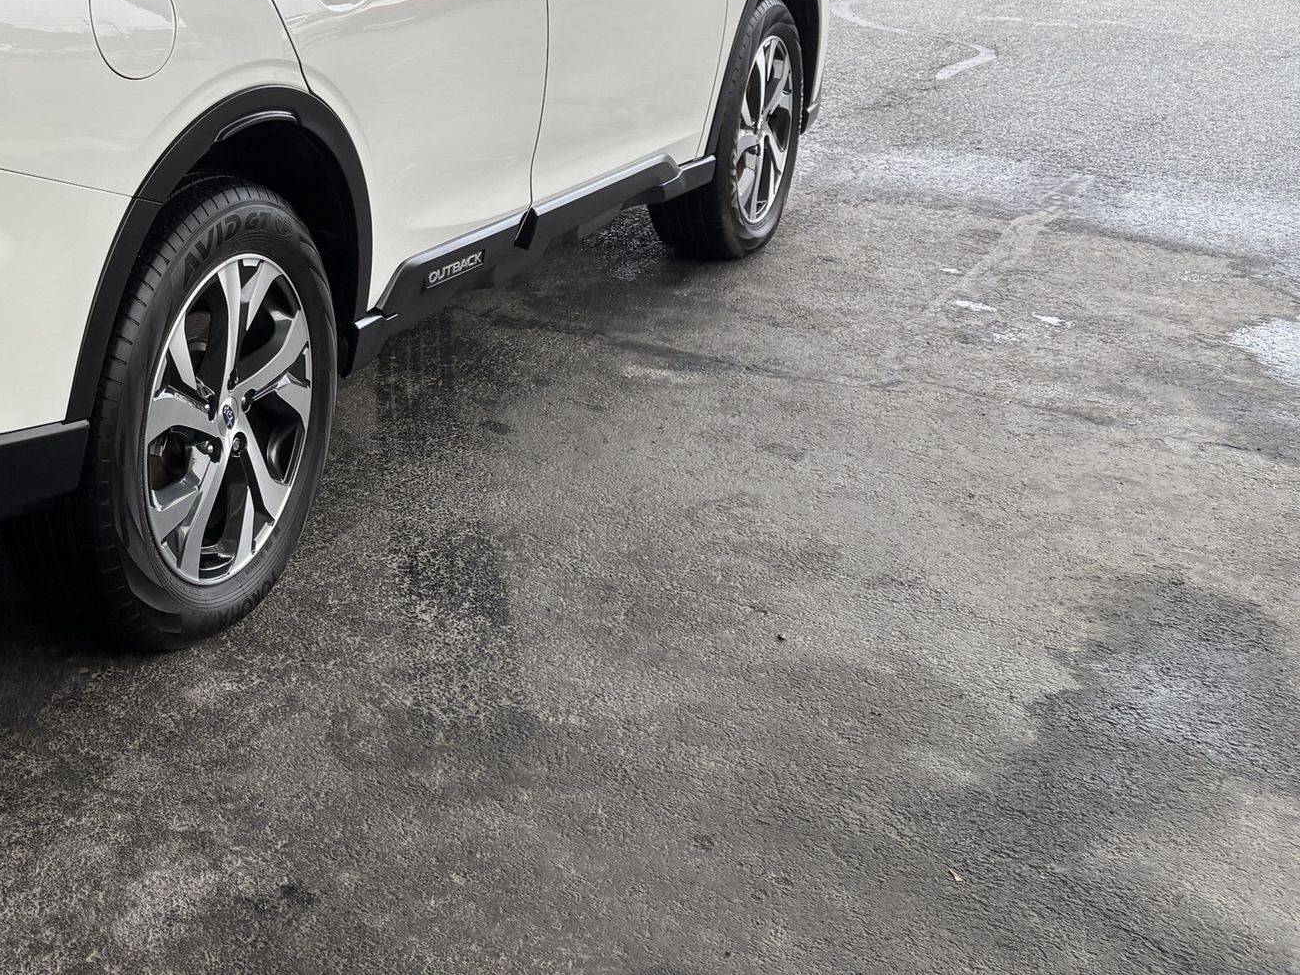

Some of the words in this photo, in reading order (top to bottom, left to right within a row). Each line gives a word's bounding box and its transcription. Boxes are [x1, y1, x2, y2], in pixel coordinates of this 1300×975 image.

[183, 214, 241, 289] AVID
[245, 211, 272, 232] GT
[428, 251, 484, 284] OUTBACK
